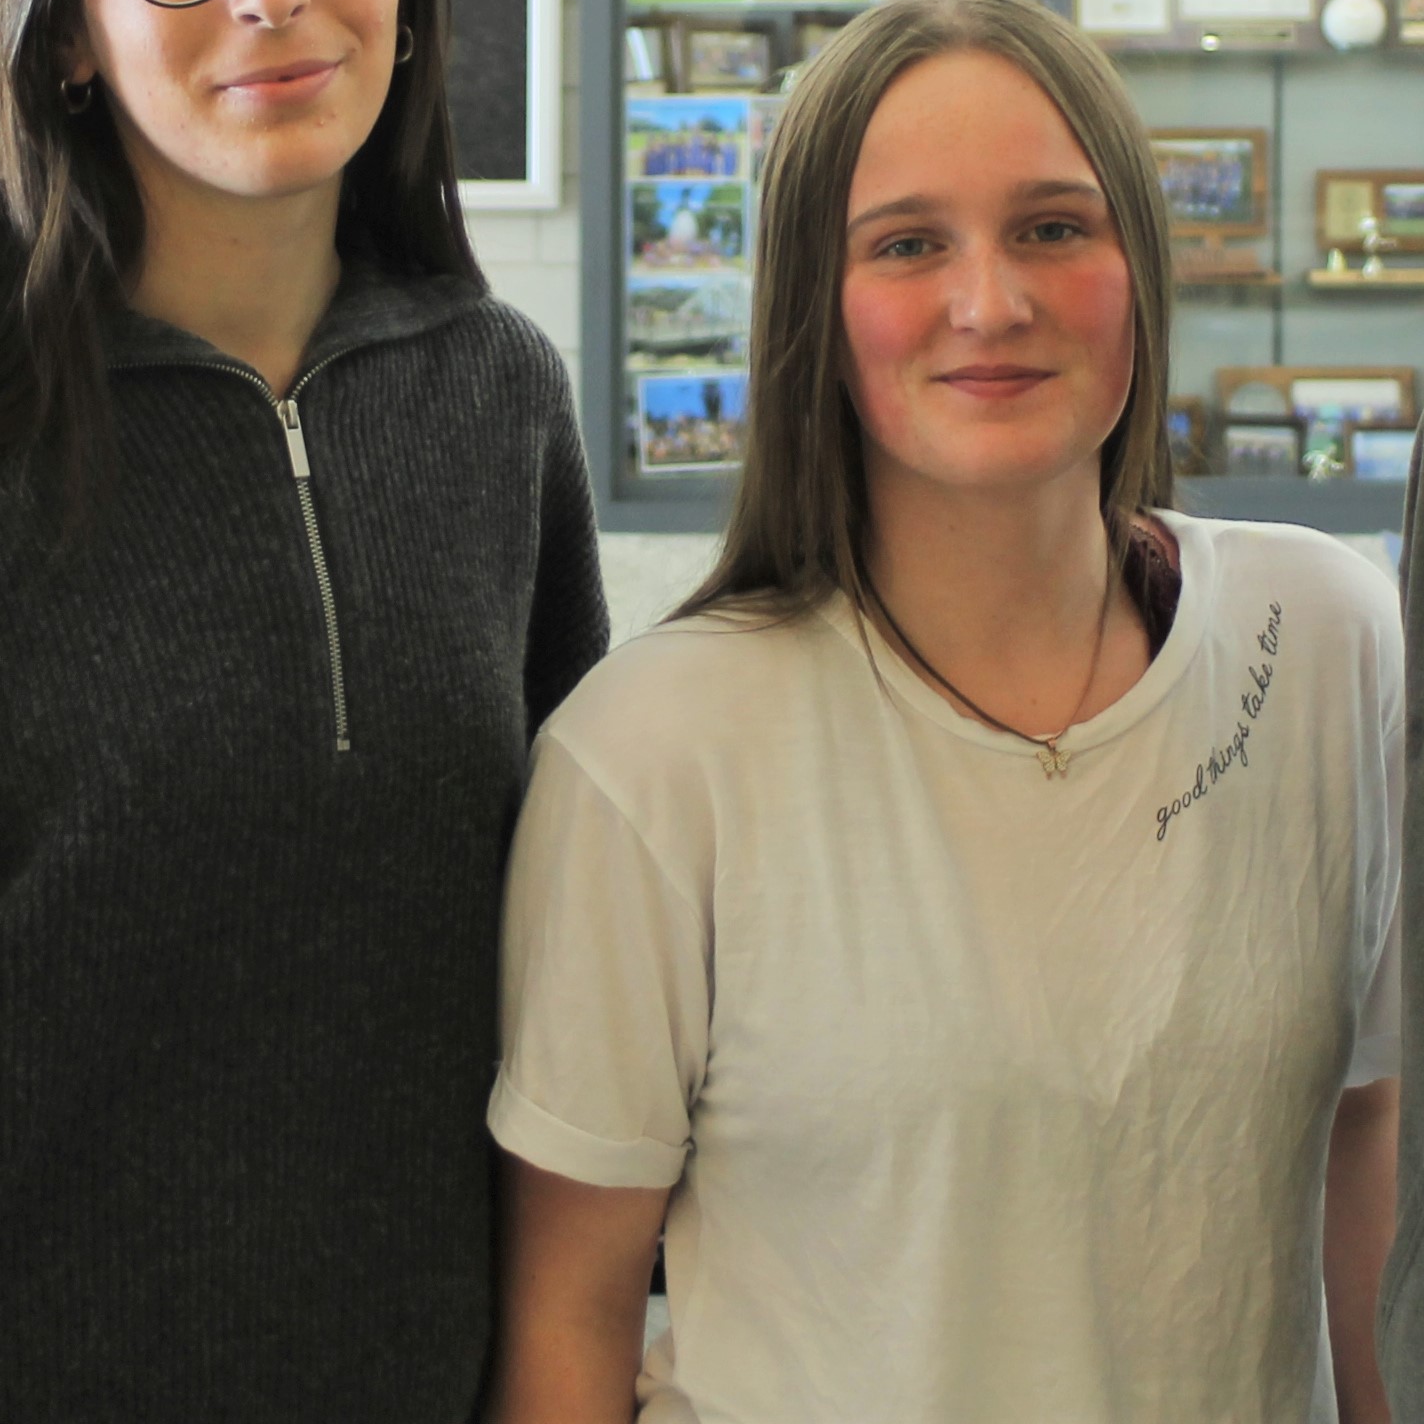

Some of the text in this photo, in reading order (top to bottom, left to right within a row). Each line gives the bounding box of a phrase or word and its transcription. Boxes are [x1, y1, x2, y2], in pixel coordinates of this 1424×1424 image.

[1156, 600, 1284, 841] good things take time
